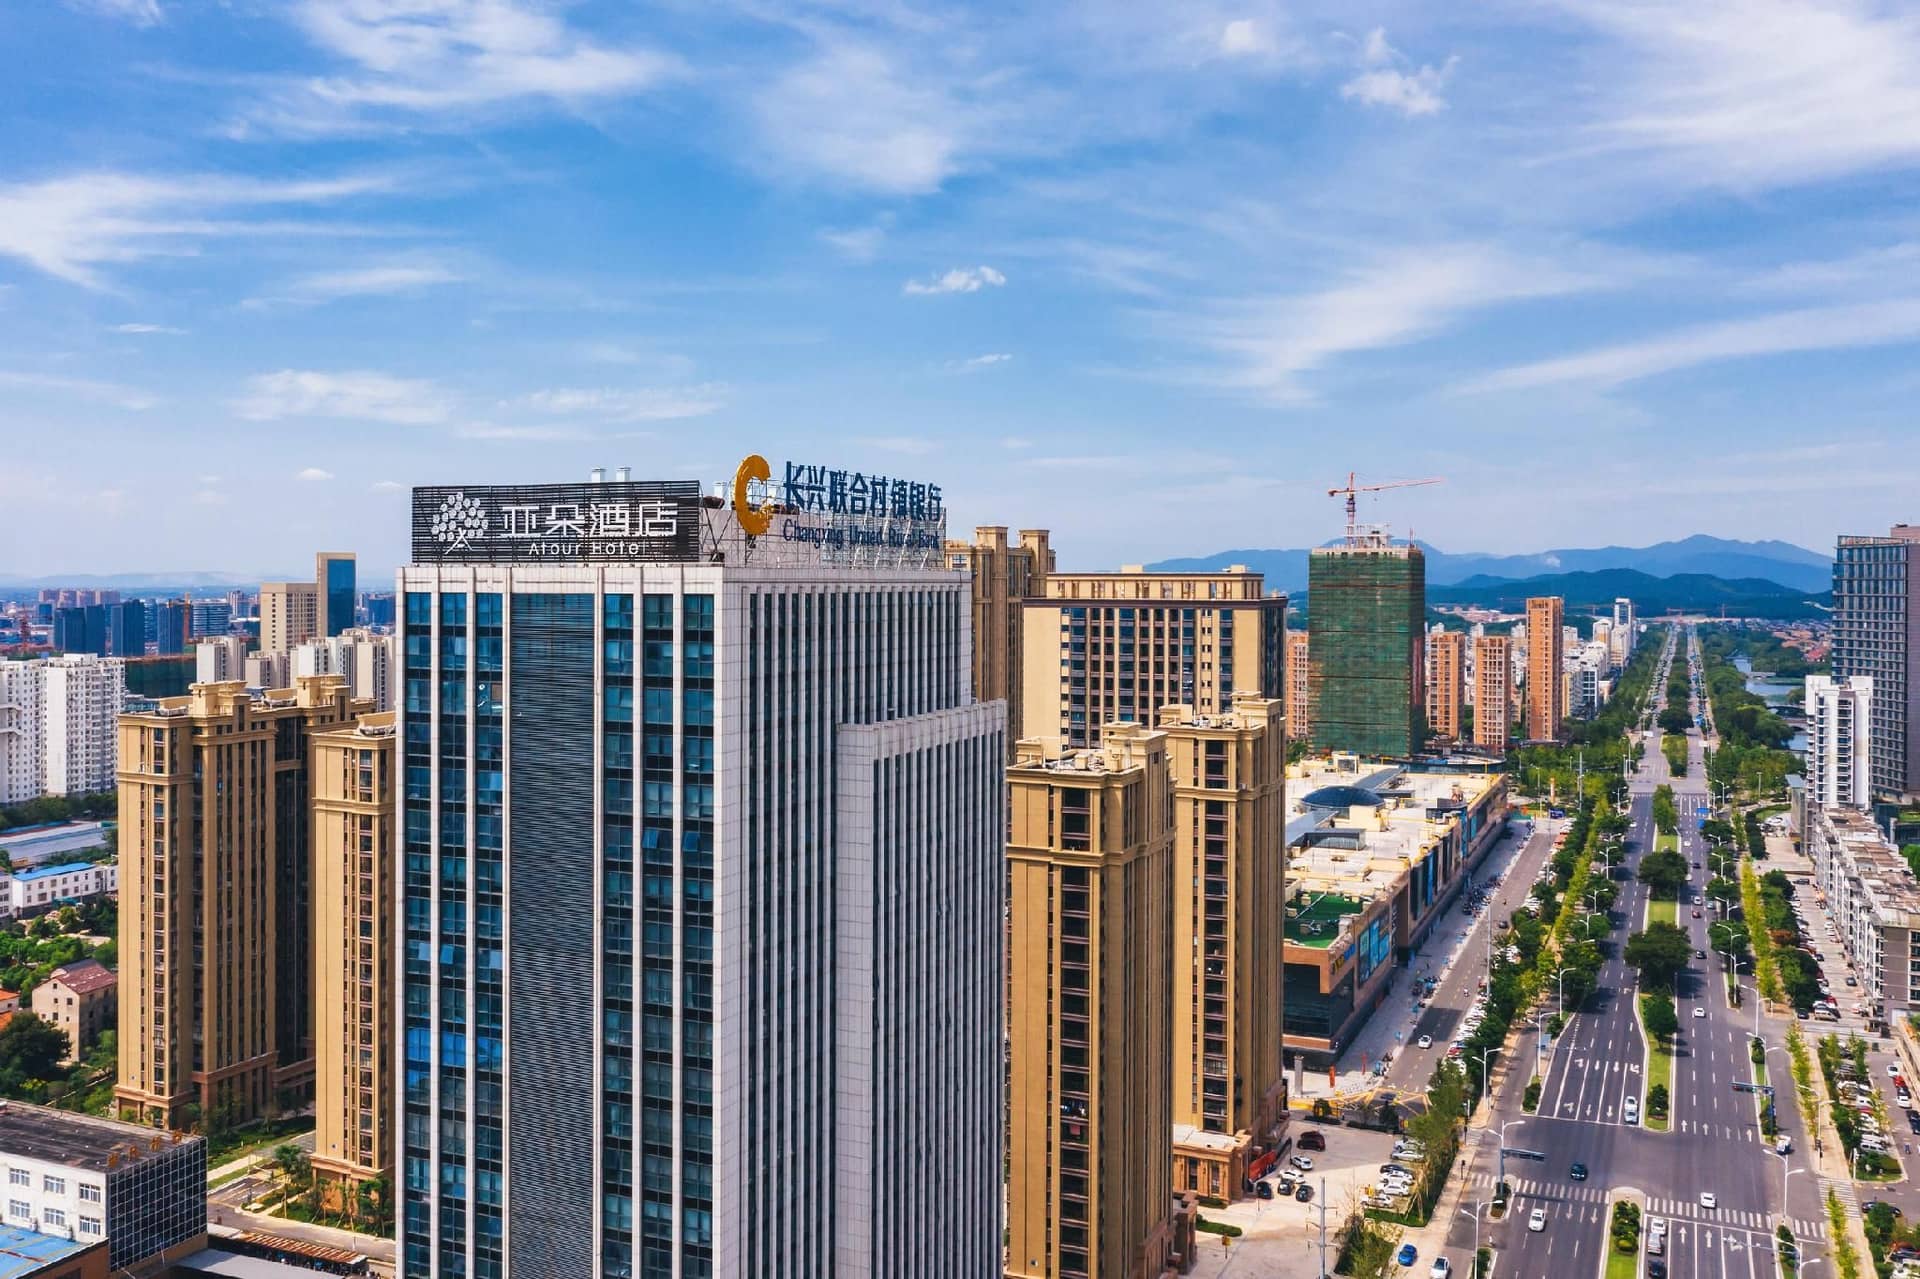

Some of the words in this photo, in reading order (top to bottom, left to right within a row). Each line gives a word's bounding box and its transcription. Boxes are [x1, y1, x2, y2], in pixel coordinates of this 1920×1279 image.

[783, 461, 942, 521] 长兴联合村镇银行
[500, 501, 678, 537] 亚朵酒店
[783, 518, 844, 549] Changxing
[528, 541, 581, 555] Atour
[592, 540, 646, 555] Hotel
